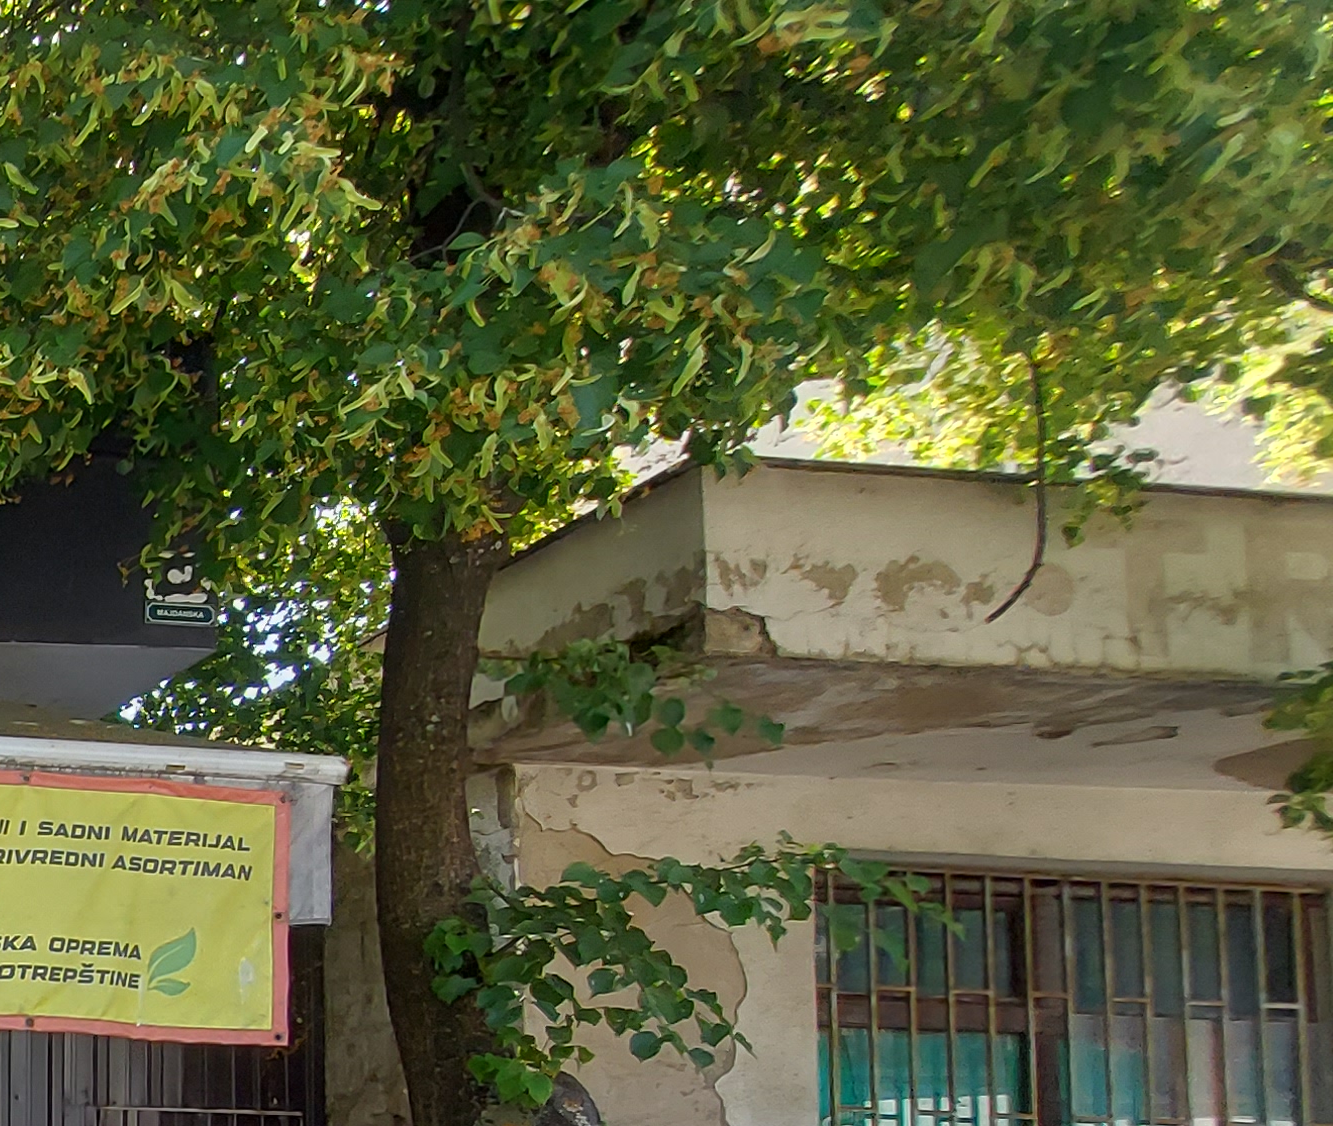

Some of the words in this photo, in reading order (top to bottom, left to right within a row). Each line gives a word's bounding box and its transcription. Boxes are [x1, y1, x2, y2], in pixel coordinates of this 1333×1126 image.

[19, 820, 27, 836] I
[37, 820, 110, 841] SADNI
[122, 825, 250, 852] MATERIJAL
[111, 854, 252, 882] ASORTIMAN
[49, 937, 142, 961] OPREMA
